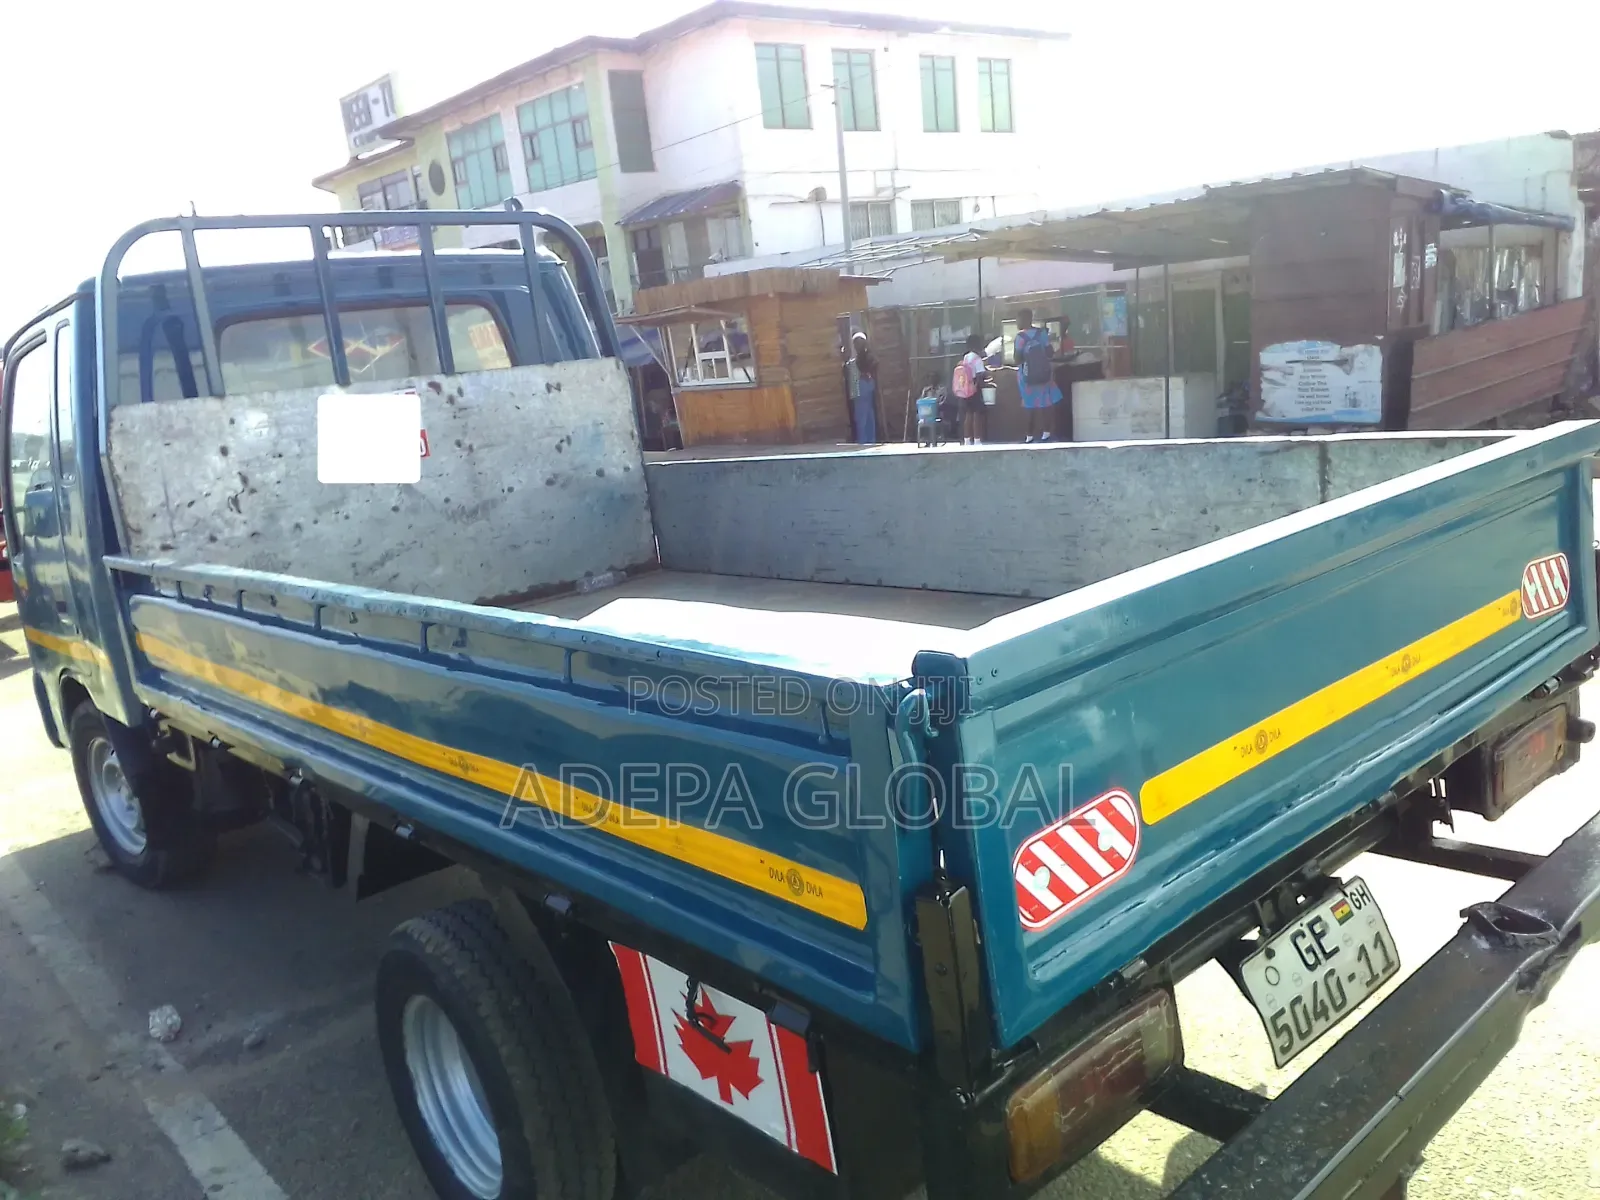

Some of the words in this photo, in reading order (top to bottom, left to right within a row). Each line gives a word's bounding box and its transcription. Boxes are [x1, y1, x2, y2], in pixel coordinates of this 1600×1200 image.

[768, 866, 785, 883] DVLA
[805, 881, 823, 898] DVLA
[1289, 914, 1340, 972] GE
[1349, 884, 1371, 911] GH
[1270, 931, 1395, 1056] 5040-11
